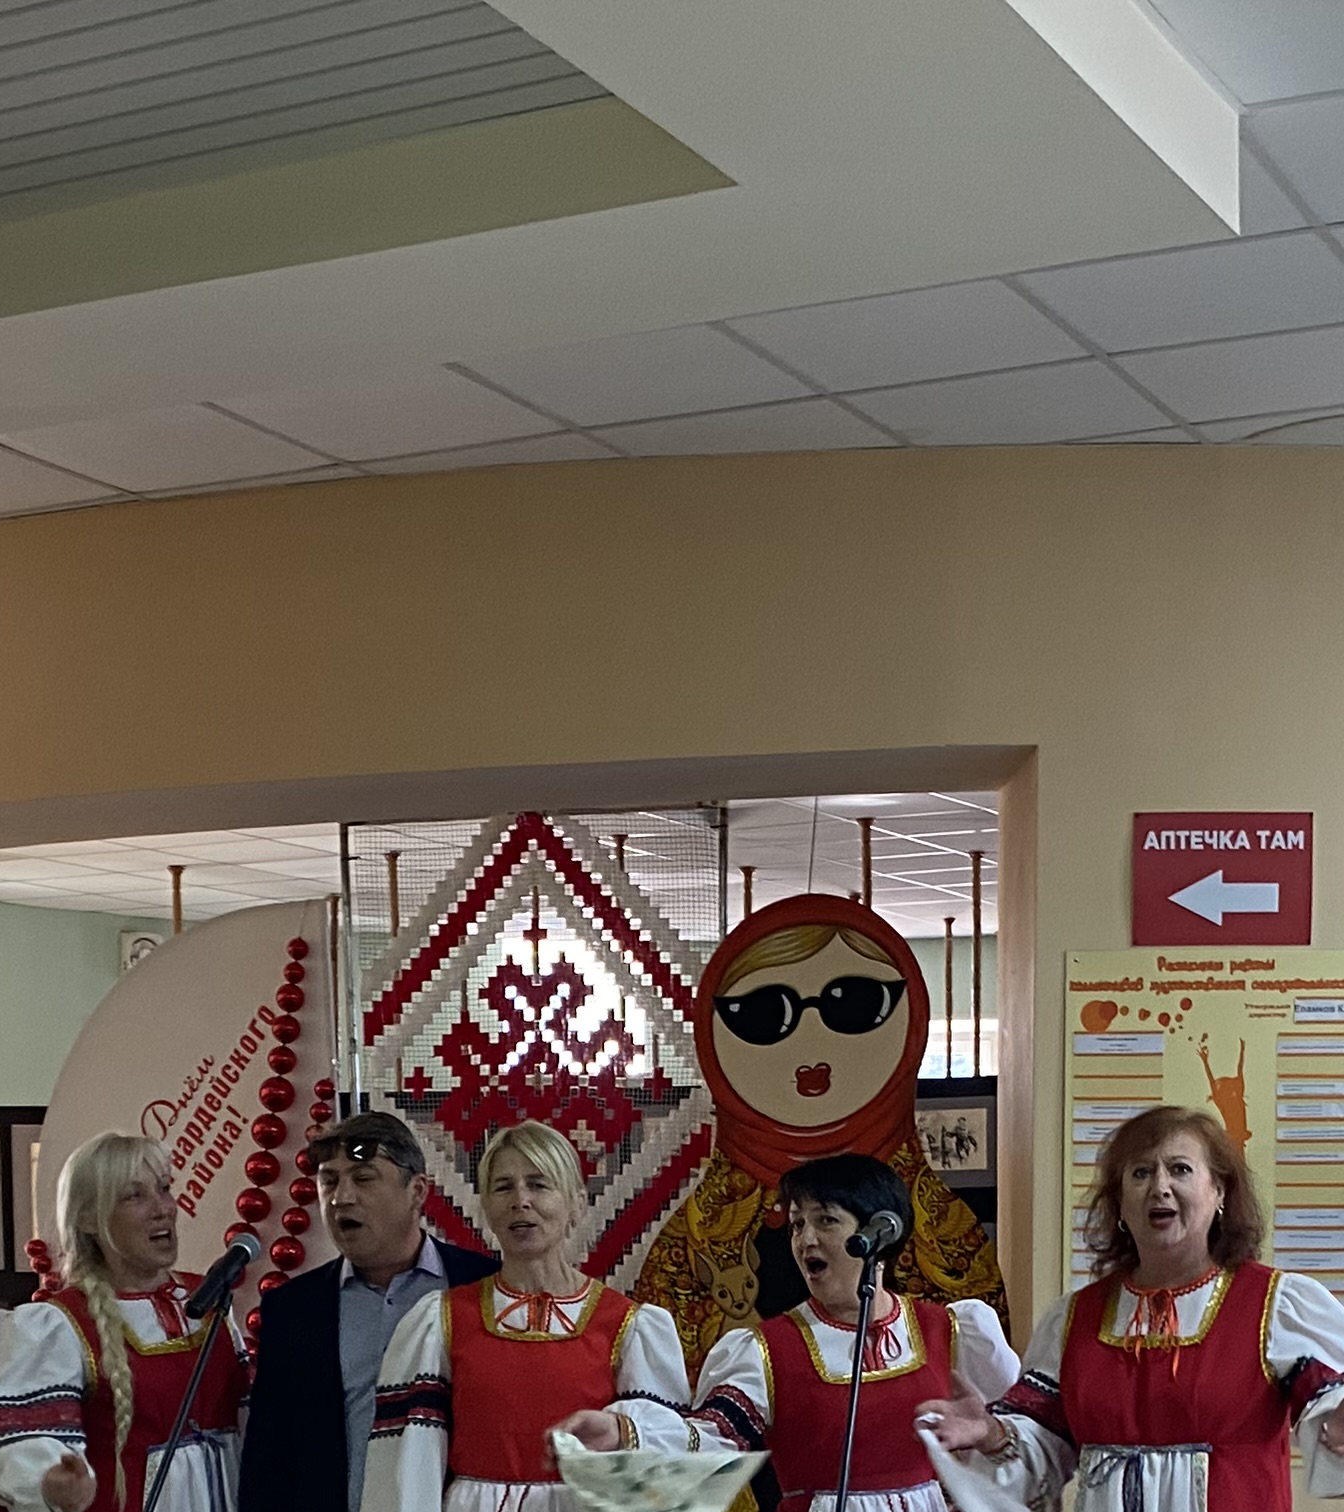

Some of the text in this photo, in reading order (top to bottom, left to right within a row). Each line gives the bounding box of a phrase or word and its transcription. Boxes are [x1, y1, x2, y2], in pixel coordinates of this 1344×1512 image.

[1143, 829, 1305, 850] АПТЕЧКА ТАМ
[140, 1054, 215, 1142] Днём
[168, 1004, 277, 1185] вардейского
[176, 1104, 250, 1219] района!
